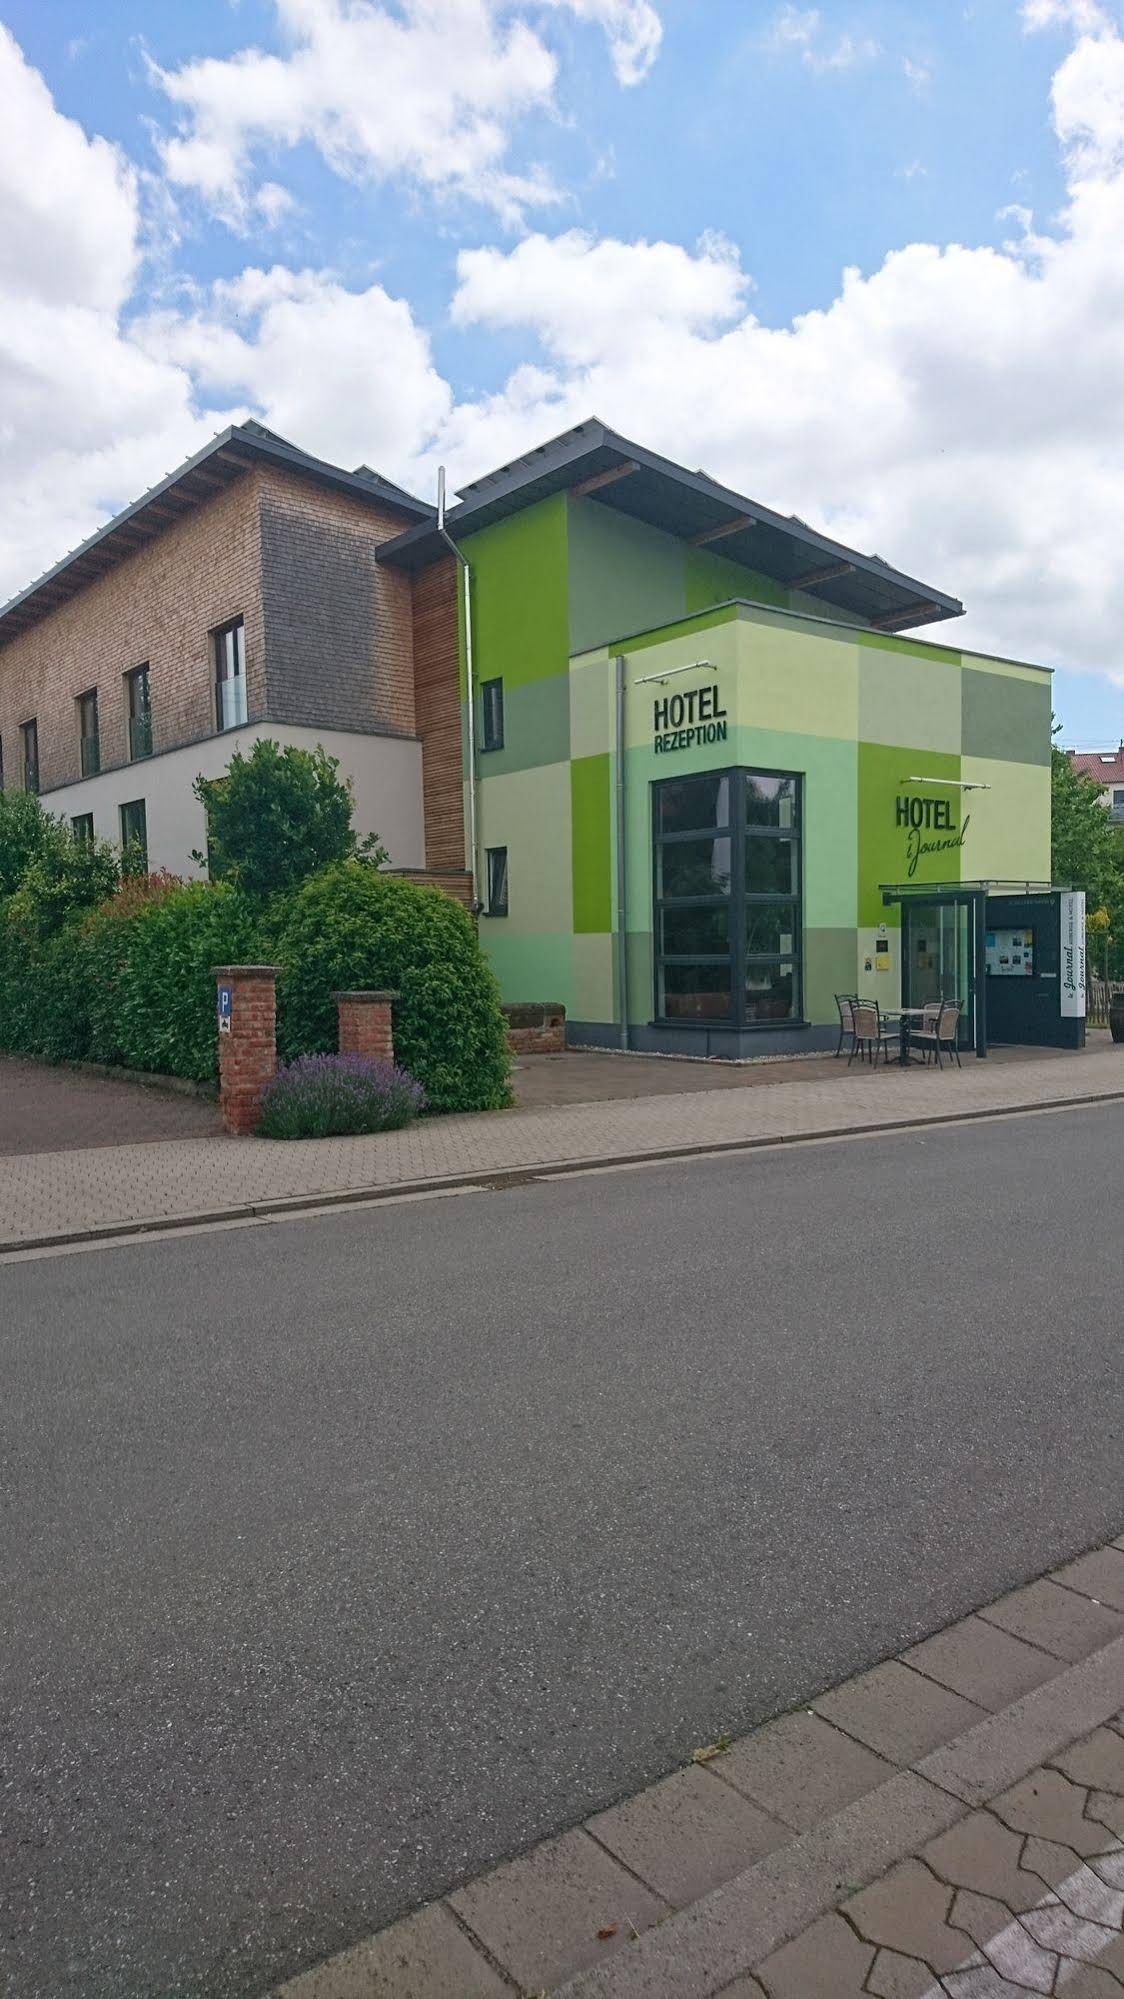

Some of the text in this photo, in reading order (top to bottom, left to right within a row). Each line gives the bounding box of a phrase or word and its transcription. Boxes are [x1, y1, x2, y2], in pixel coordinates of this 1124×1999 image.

[654, 684, 727, 731] HOTEL
[654, 720, 727, 754] REZEPTION
[896, 795, 956, 830] HOTEL
[908, 828, 970, 877] Journal
[1063, 946, 1076, 991] Journal
[222, 992, 228, 1012] P
